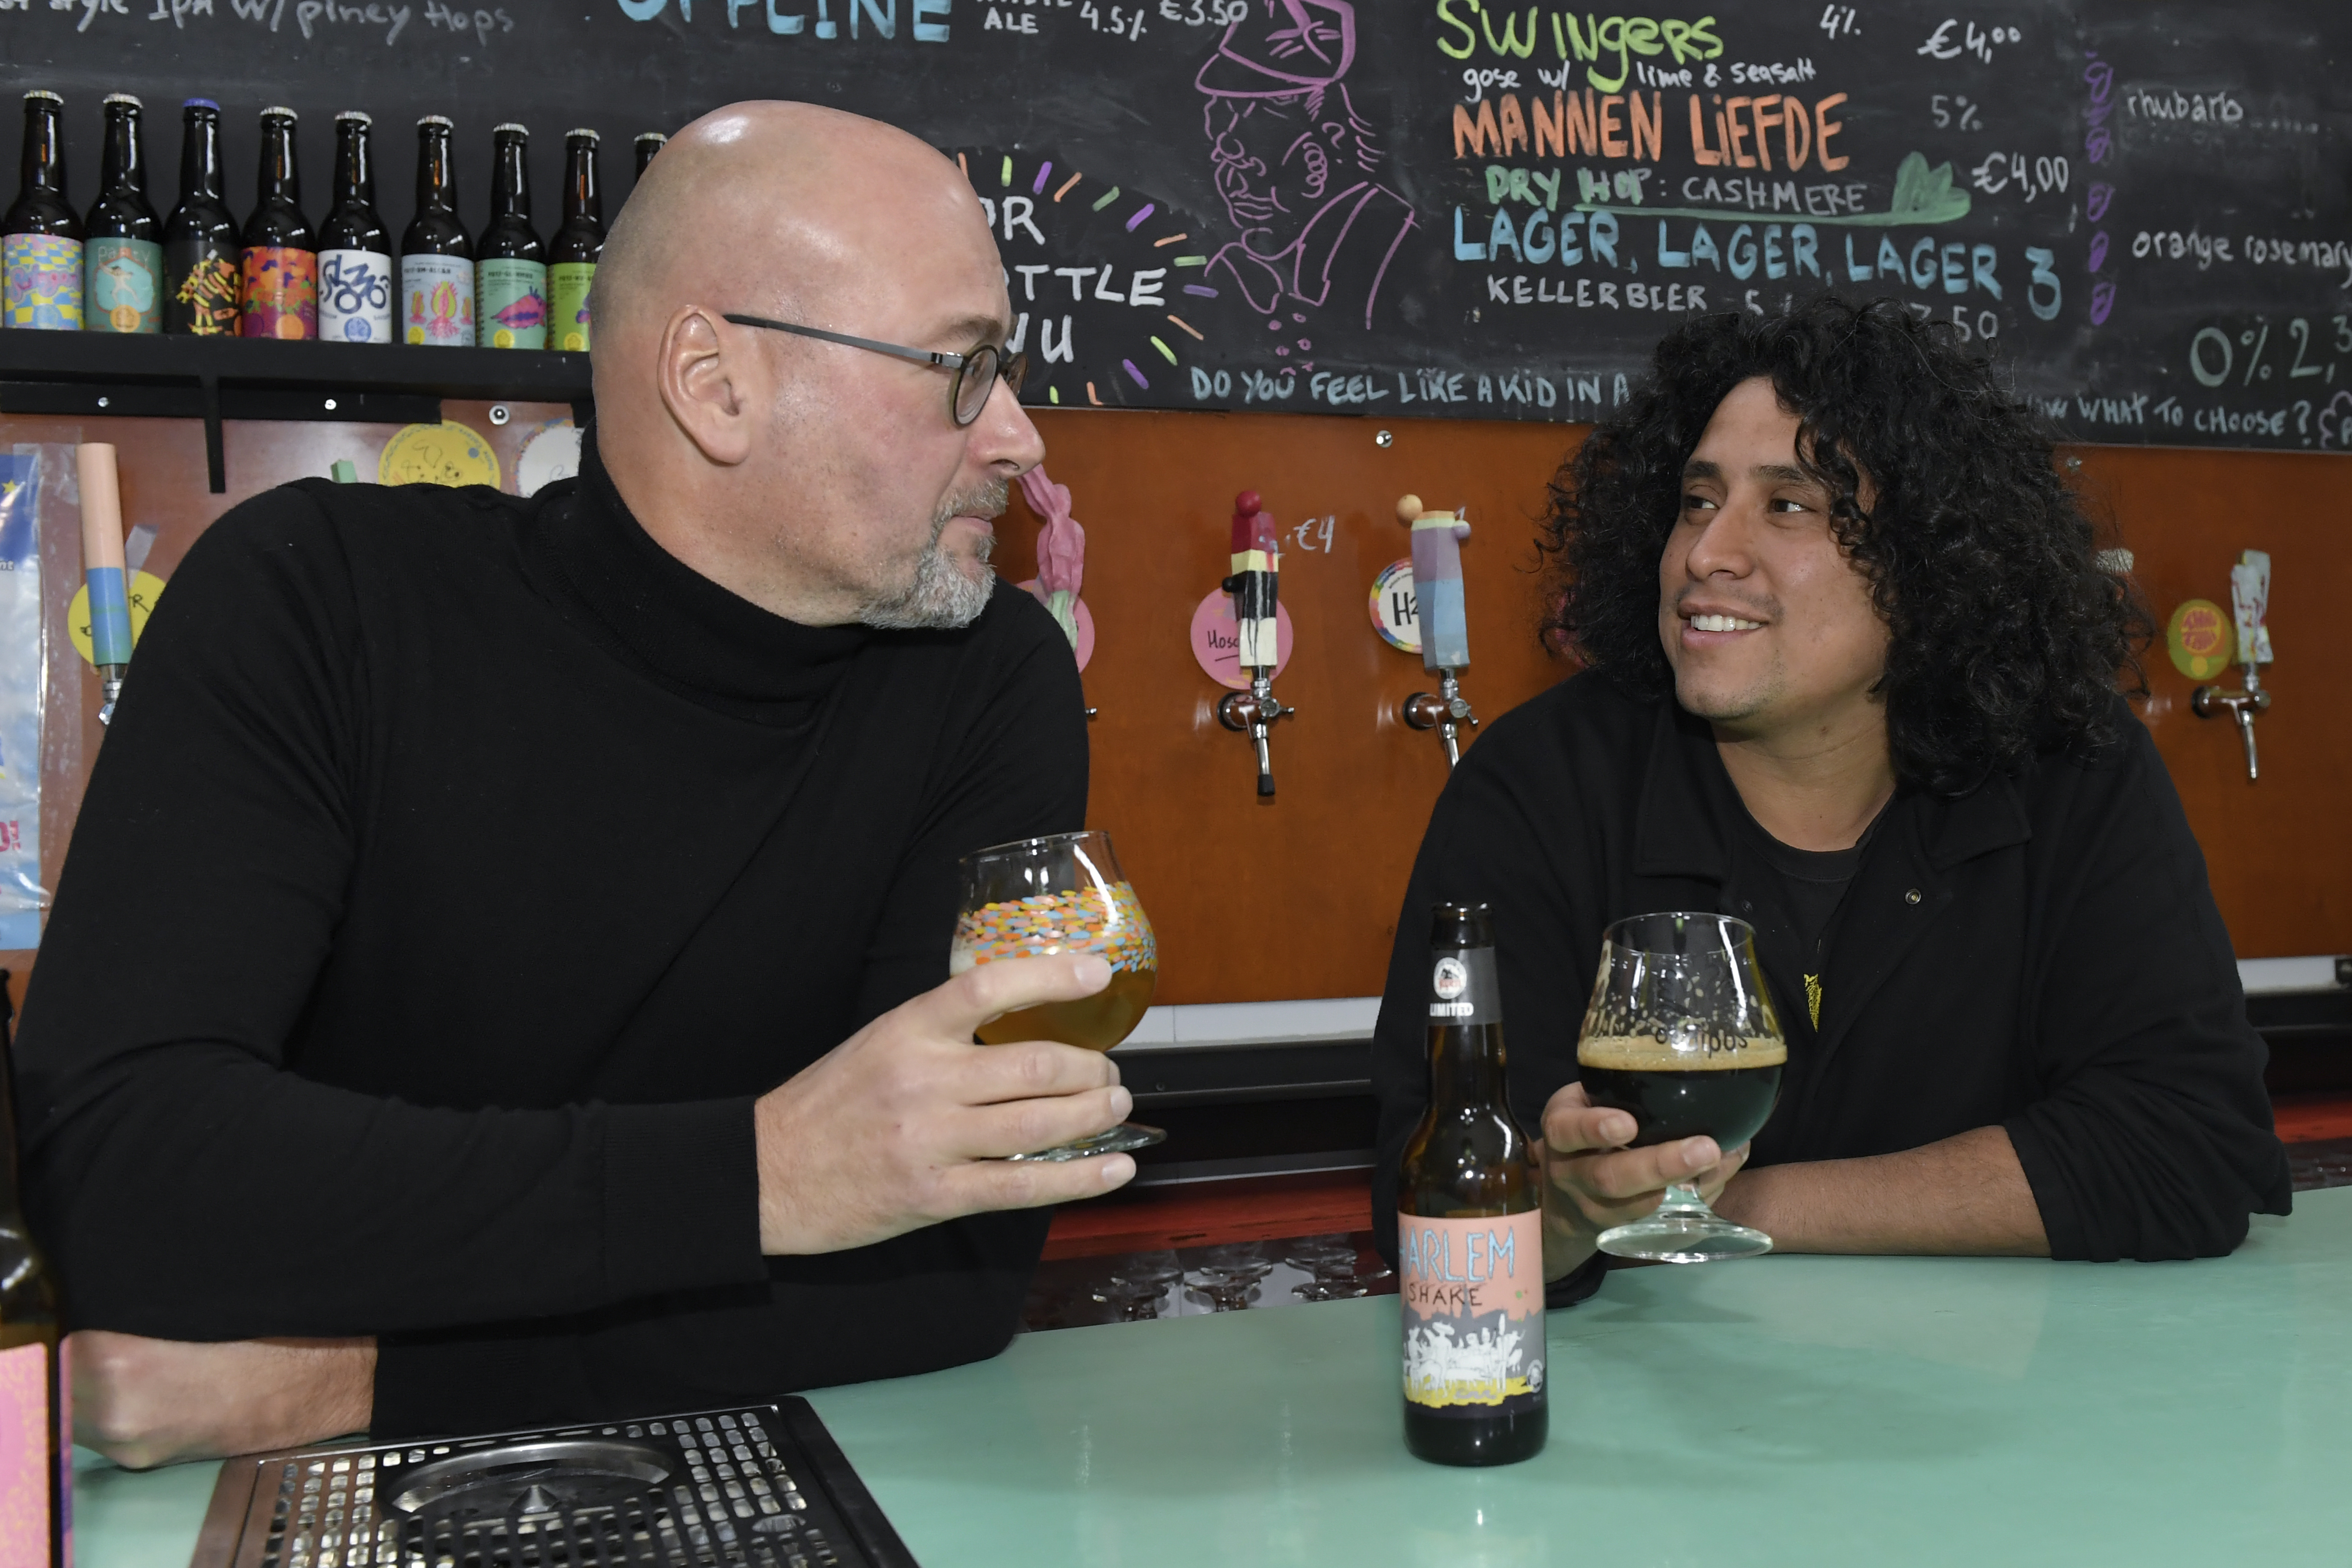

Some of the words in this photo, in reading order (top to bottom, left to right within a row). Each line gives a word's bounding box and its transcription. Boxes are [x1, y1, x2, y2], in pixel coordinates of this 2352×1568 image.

[297, 0, 411, 46] piney
[984, 7, 1039, 33] ALE
[1463, 68, 1521, 103] gose
[1636, 61, 1692, 87] lime
[1703, 63, 1722, 87] &
[1453, 87, 1662, 162] MANNEN
[1931, 95, 1983, 131] 5%
[2127, 88, 2243, 123] rhubarb
[1485, 164, 1560, 211] DRY
[1682, 177, 1867, 216] CASHMERE
[1846, 233, 2002, 301] LAGER
[2132, 229, 2234, 271] orange
[1004, 263, 1167, 306] TTLE
[1487, 274, 1707, 311] KELLERBIER
[2190, 324, 2271, 387] 0%
[1191, 366, 1231, 400] DO
[1240, 370, 1295, 404] YOU
[1310, 371, 1390, 406] FEEL
[1478, 375, 1493, 403] A
[1567, 376, 1601, 405] IN
[2077, 391, 2149, 425] WHAT
[2153, 396, 2184, 427] TO
[1408, 1282, 1483, 1306] SHAKE
